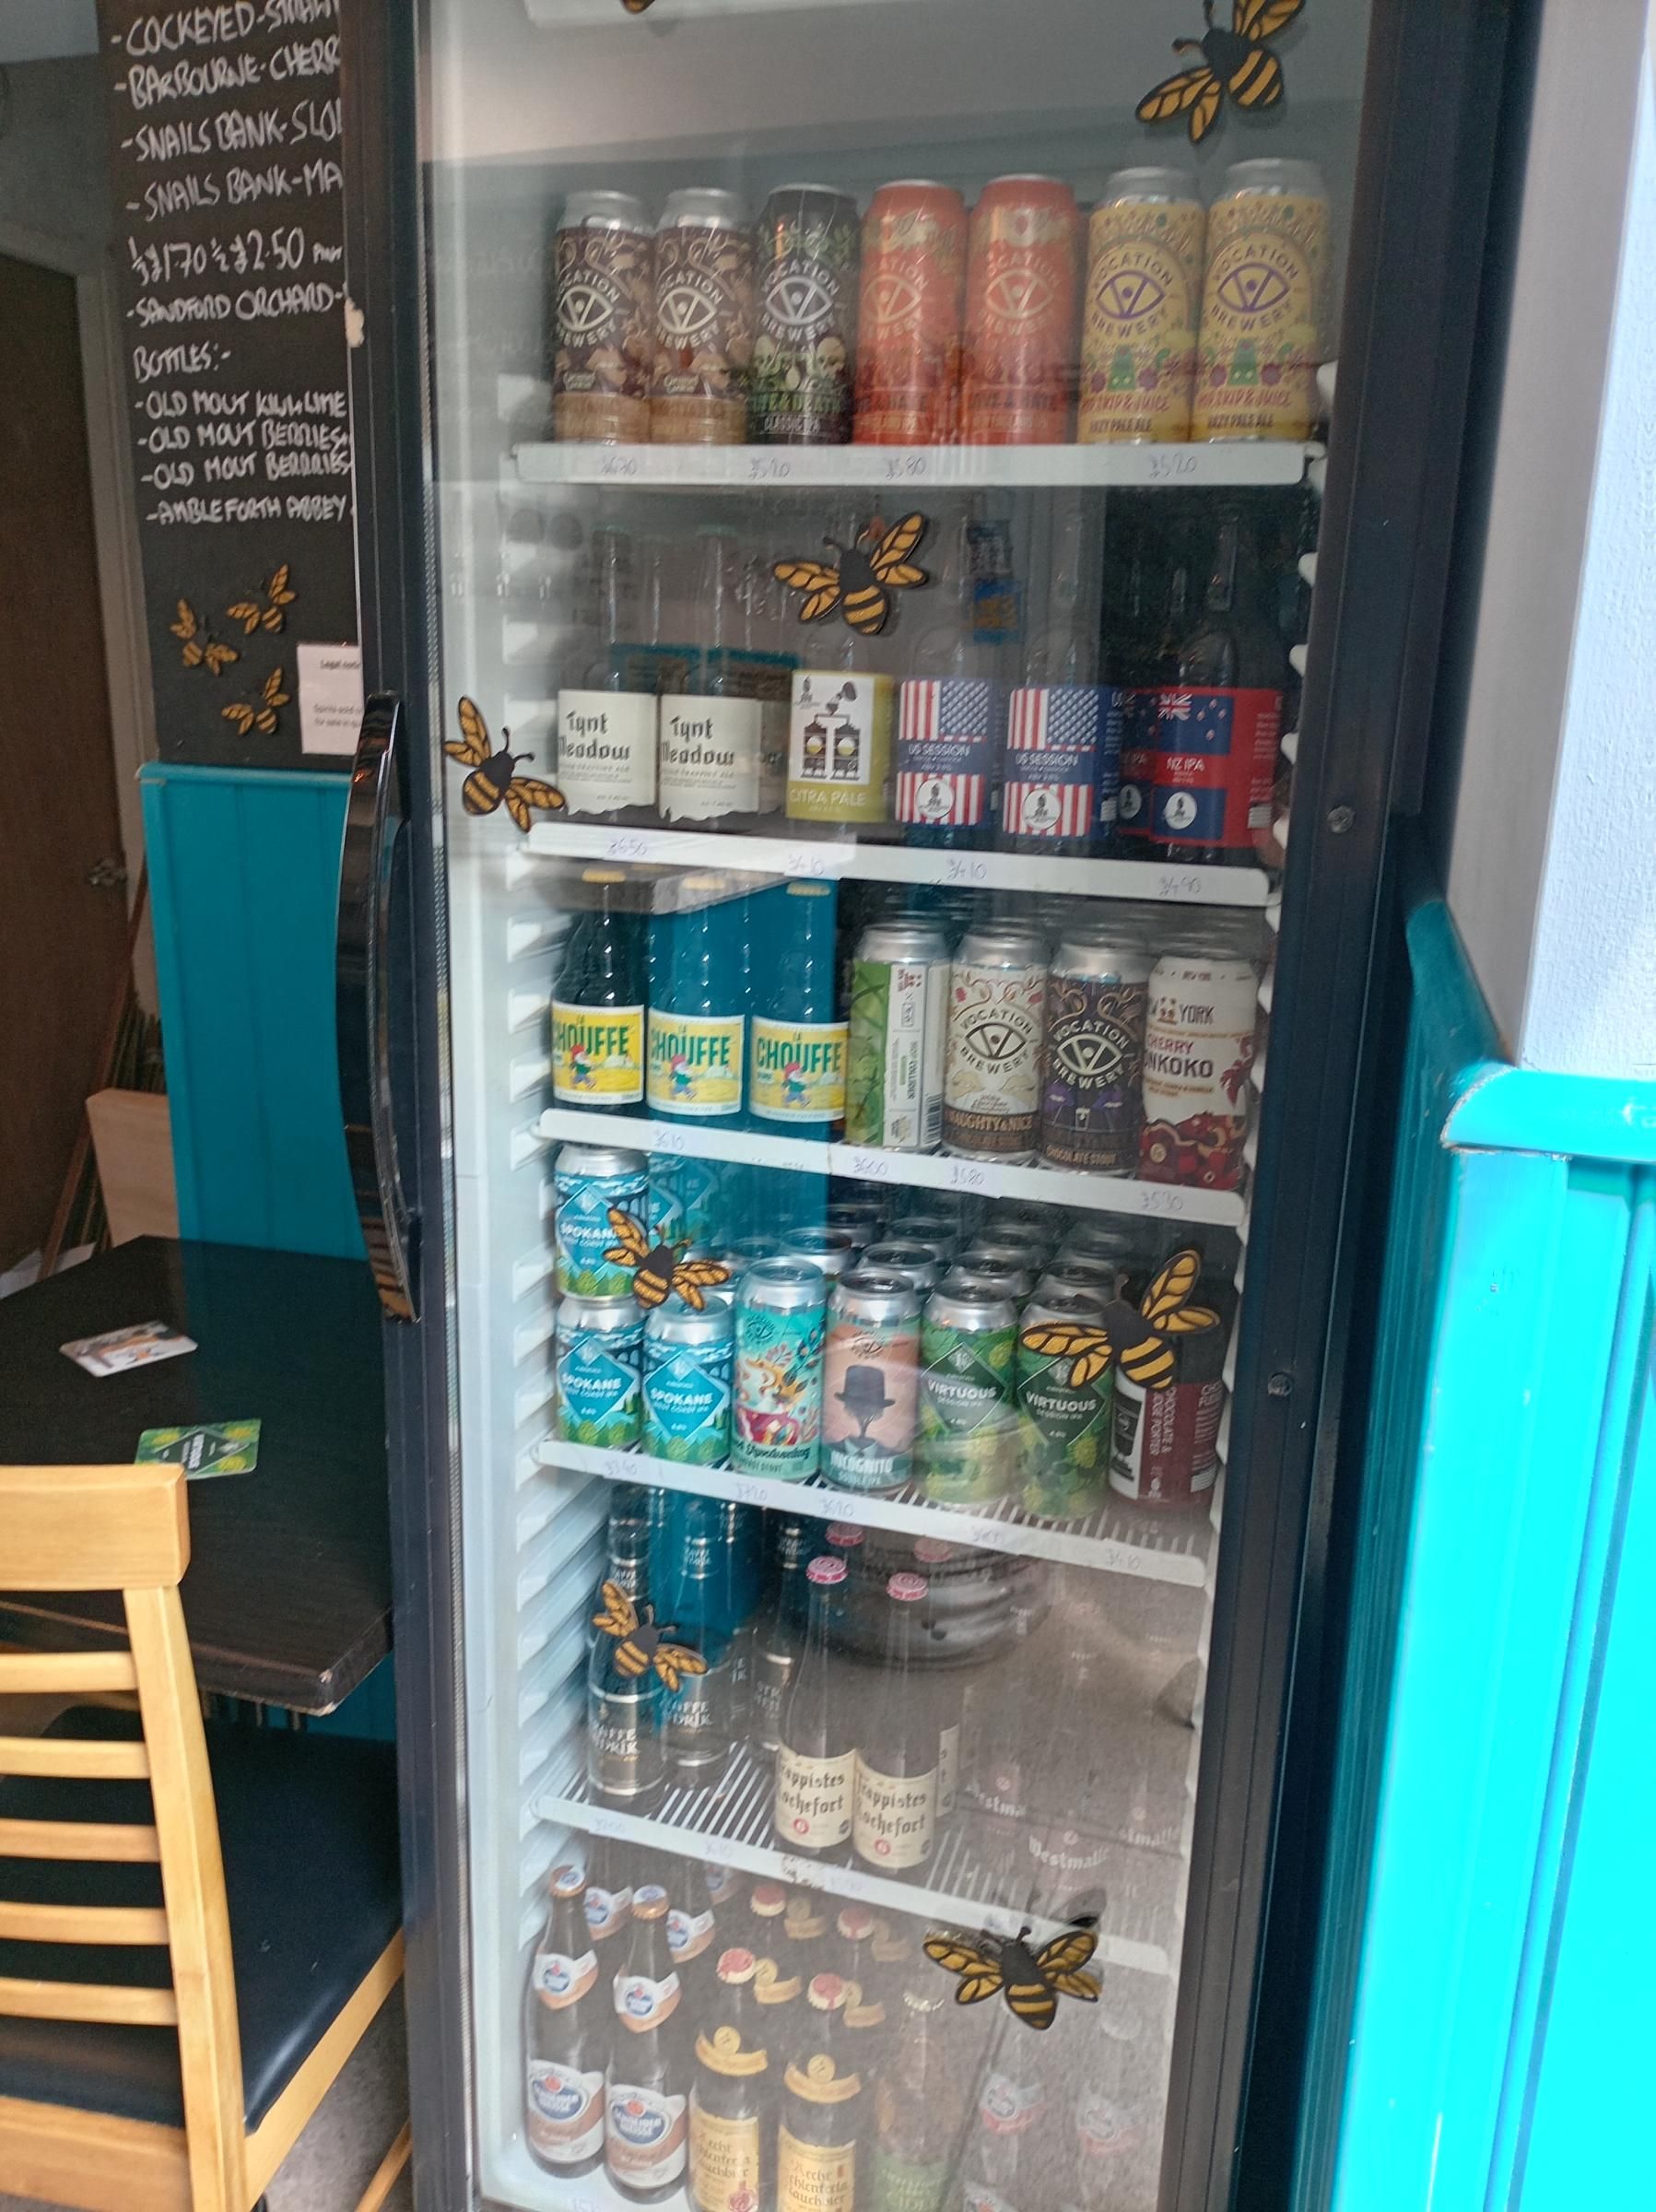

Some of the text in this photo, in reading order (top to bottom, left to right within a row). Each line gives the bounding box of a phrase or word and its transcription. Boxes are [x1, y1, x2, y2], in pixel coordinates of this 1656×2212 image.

[1098, 252, 1175, 290] OCATION
[1220, 243, 1300, 281] OCATION
[1052, 1018, 1130, 1050] VOCATION
[1144, 1052, 1214, 1078] NKOKO
[927, 1380, 997, 1400] VIRTUOUS
[1026, 1391, 1097, 1412] VIRTUOUS
[781, 1792, 843, 1818] ochefort
[863, 1811, 926, 1838] ochefort
